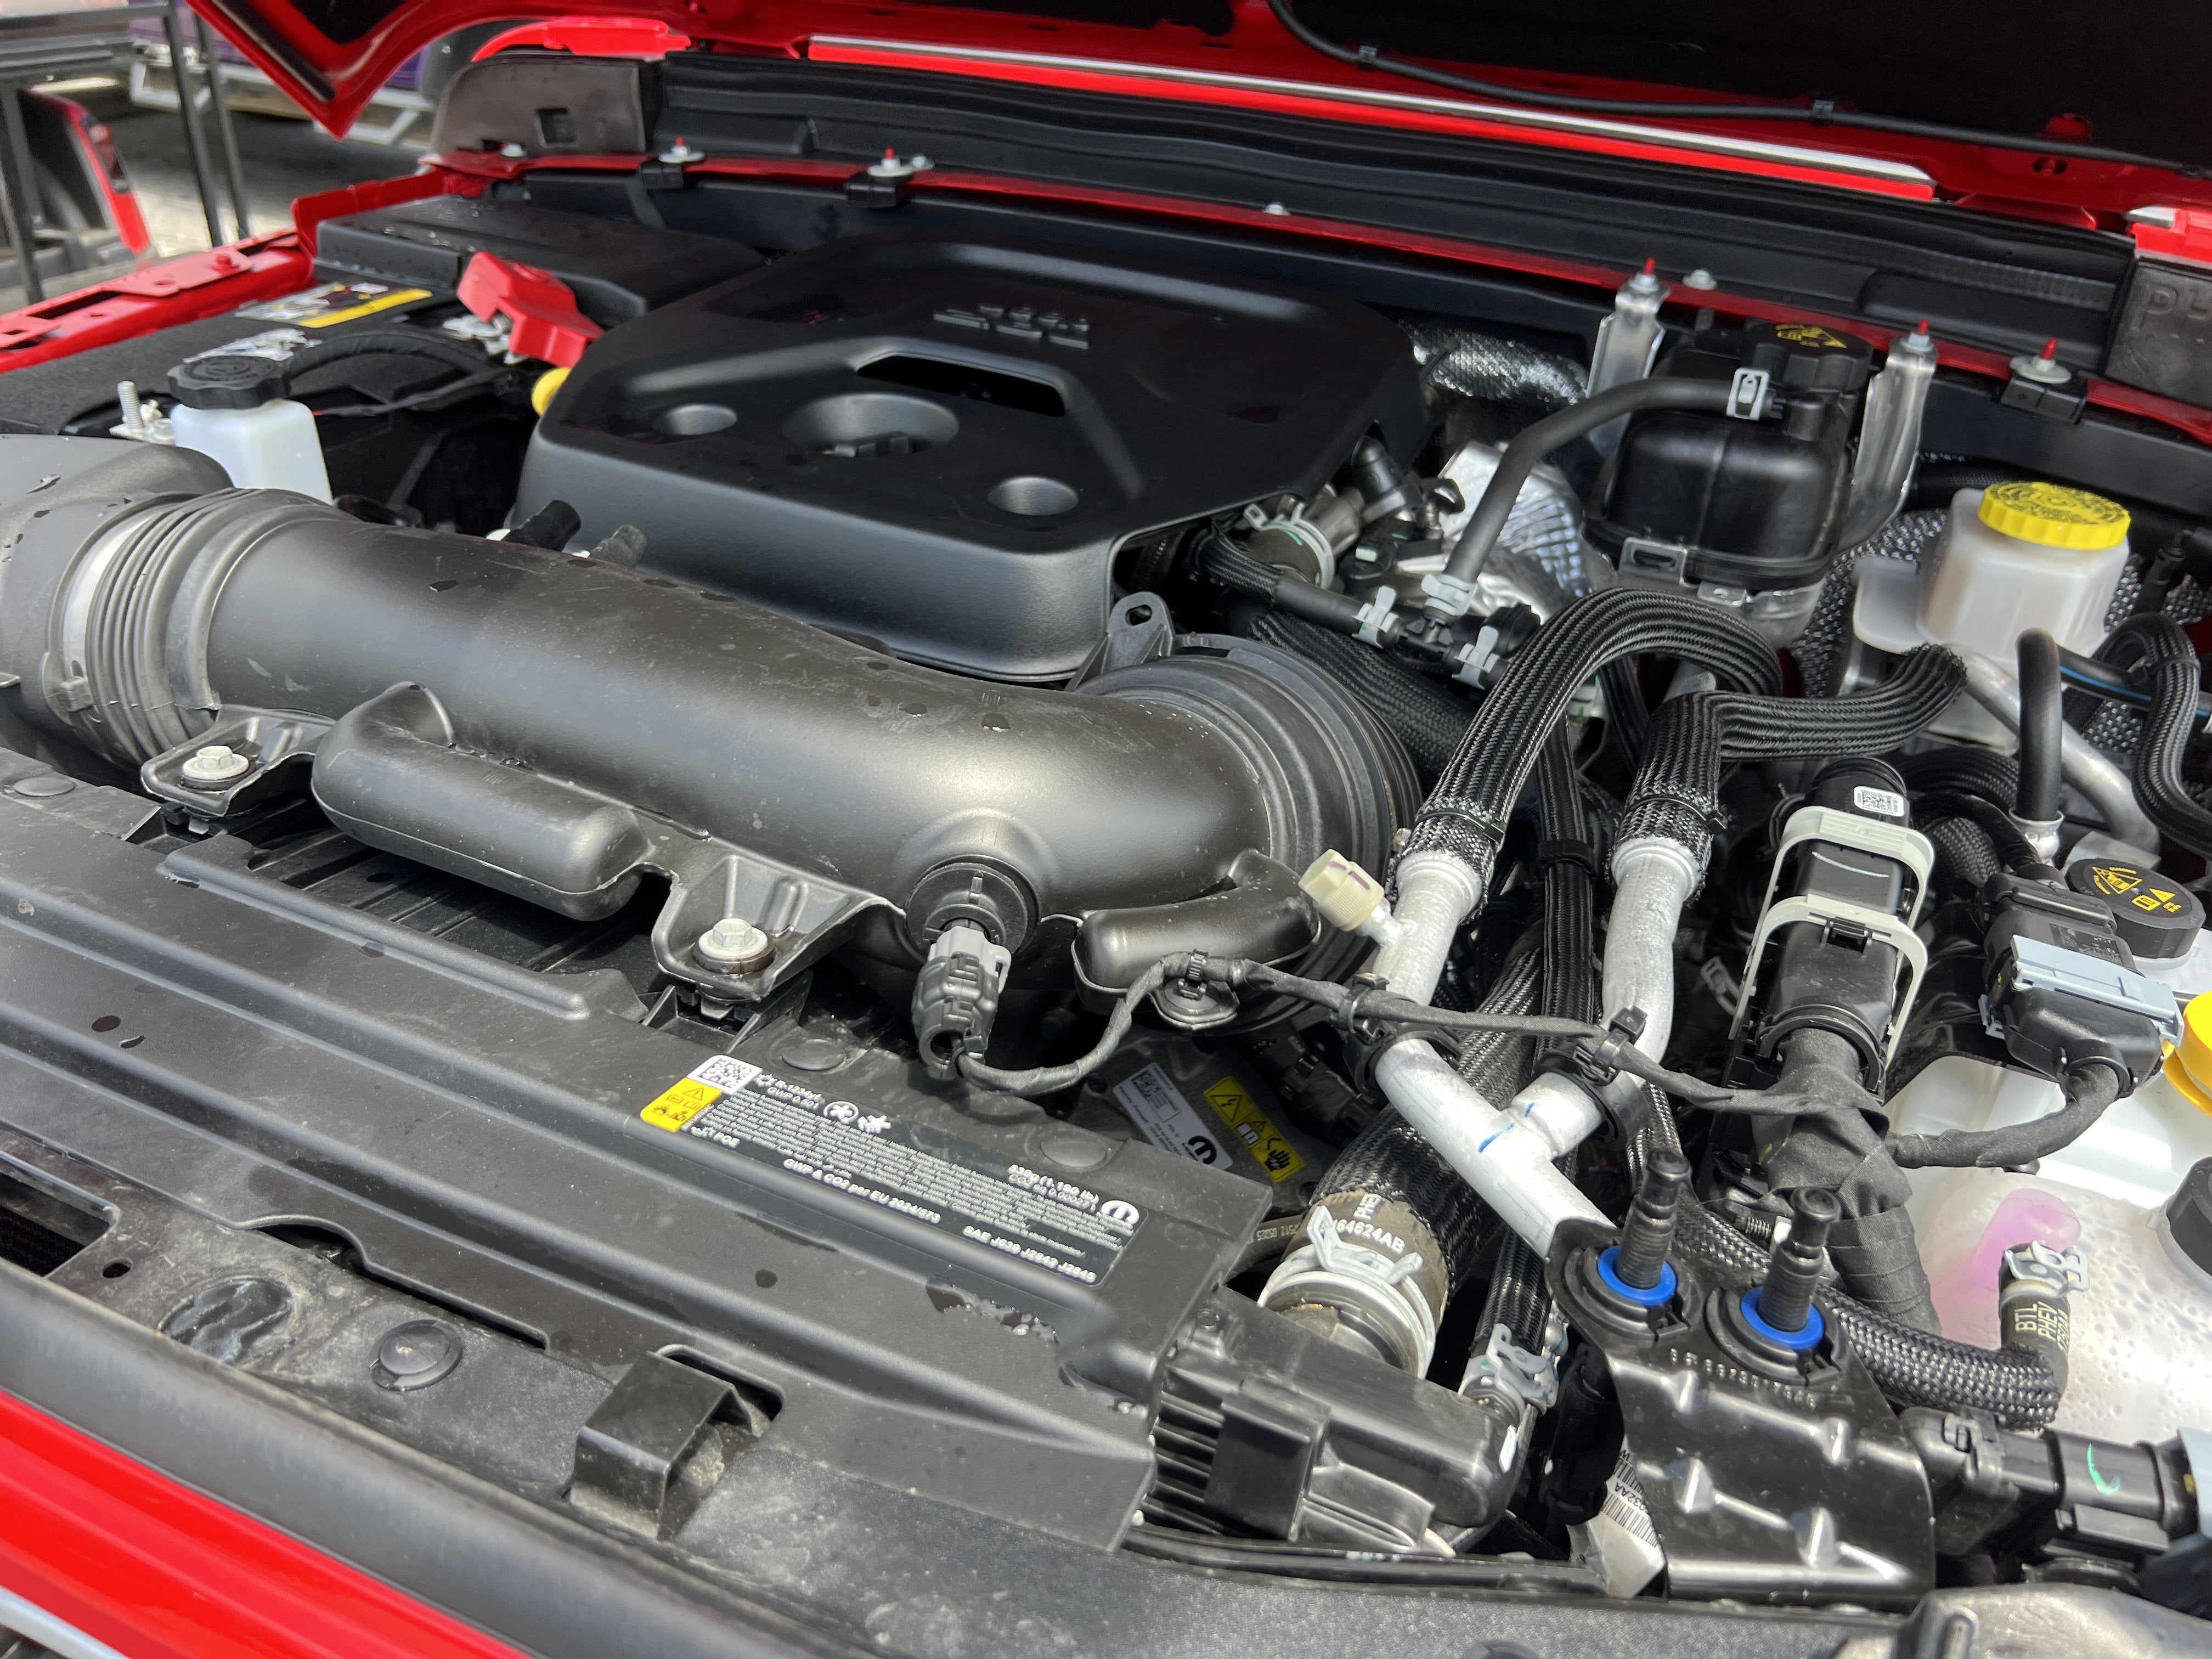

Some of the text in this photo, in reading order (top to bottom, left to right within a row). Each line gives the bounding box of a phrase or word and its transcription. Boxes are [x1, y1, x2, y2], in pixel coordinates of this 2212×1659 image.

[768, 1086, 794, 1101] GWP
[714, 1132, 740, 1148] POE
[783, 1159, 814, 1174] GWP
[824, 1173, 850, 1189] CO2
[848, 1183, 871, 1198] per
[870, 1190, 890, 1204] EU
[1009, 1174, 1033, 1189] CO2
[963, 1225, 1096, 1283] SAE J639 J2842 J2845
[2015, 1304, 2038, 1332] BTL
[2038, 1301, 2057, 1341] PHEV
